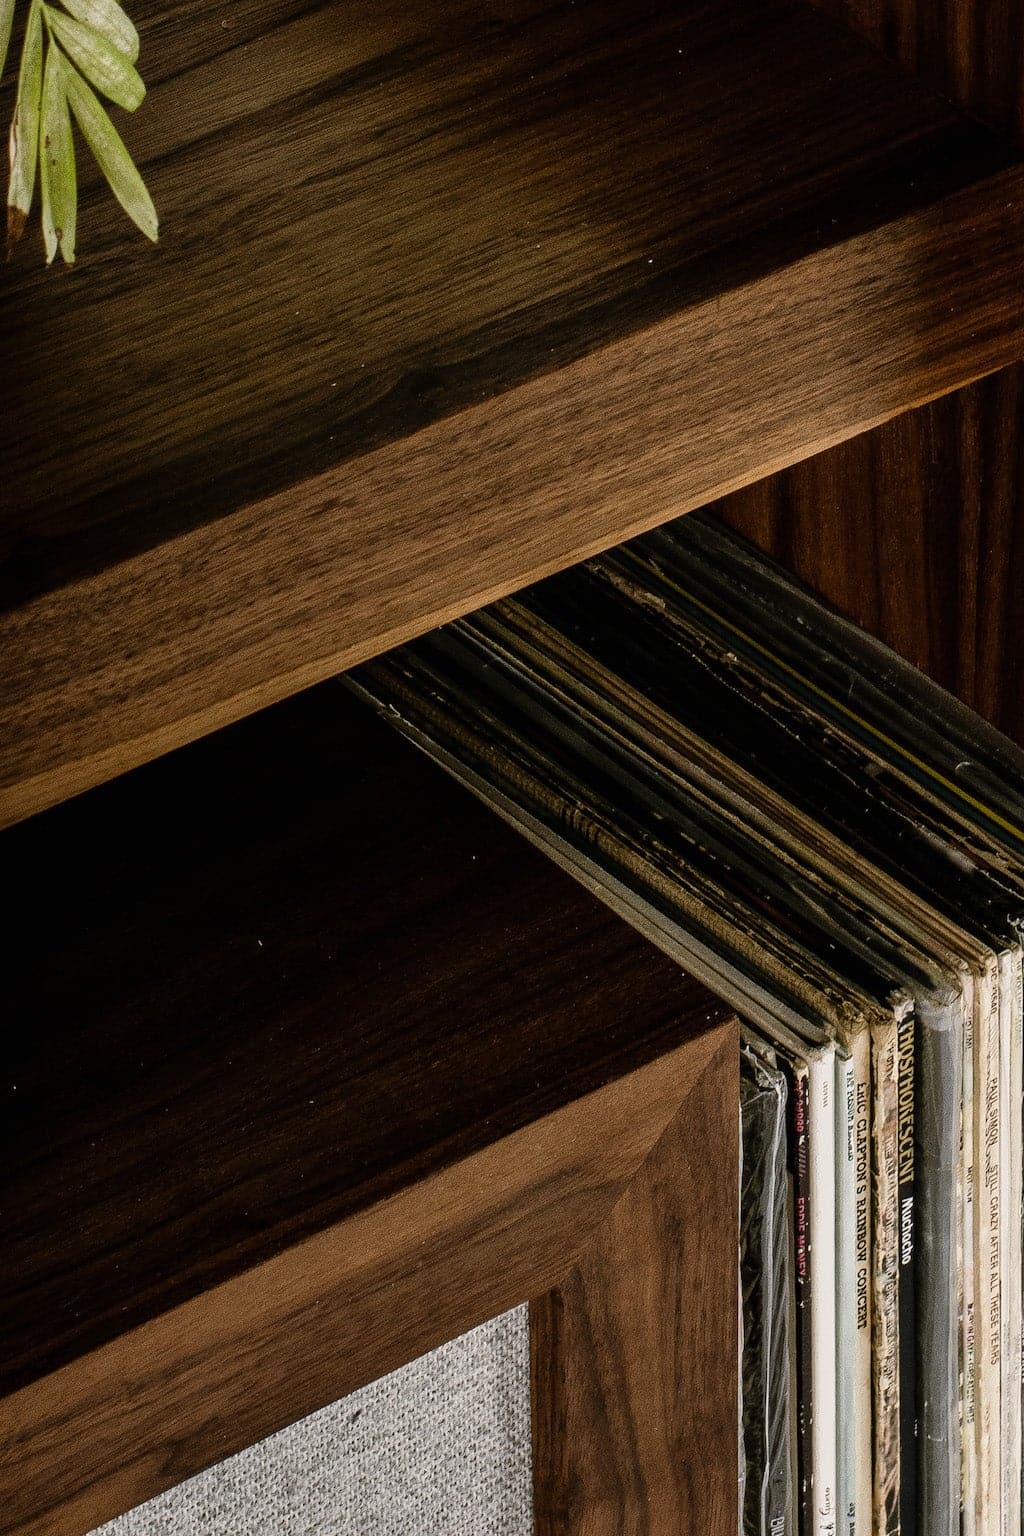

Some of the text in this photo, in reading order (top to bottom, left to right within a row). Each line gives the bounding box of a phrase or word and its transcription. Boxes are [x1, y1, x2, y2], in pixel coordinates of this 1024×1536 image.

[856, 1082, 868, 1330] ERIC CLAPTON'S RAINBOW CONCERT
[898, 1020, 915, 1265] PHOSPHORESCENT Muchacho
[989, 1077, 999, 1366] PAUL SIMON STILL CRAZY AFTER ALL THESE YEARS
[819, 1487, 833, 1516] Guero
